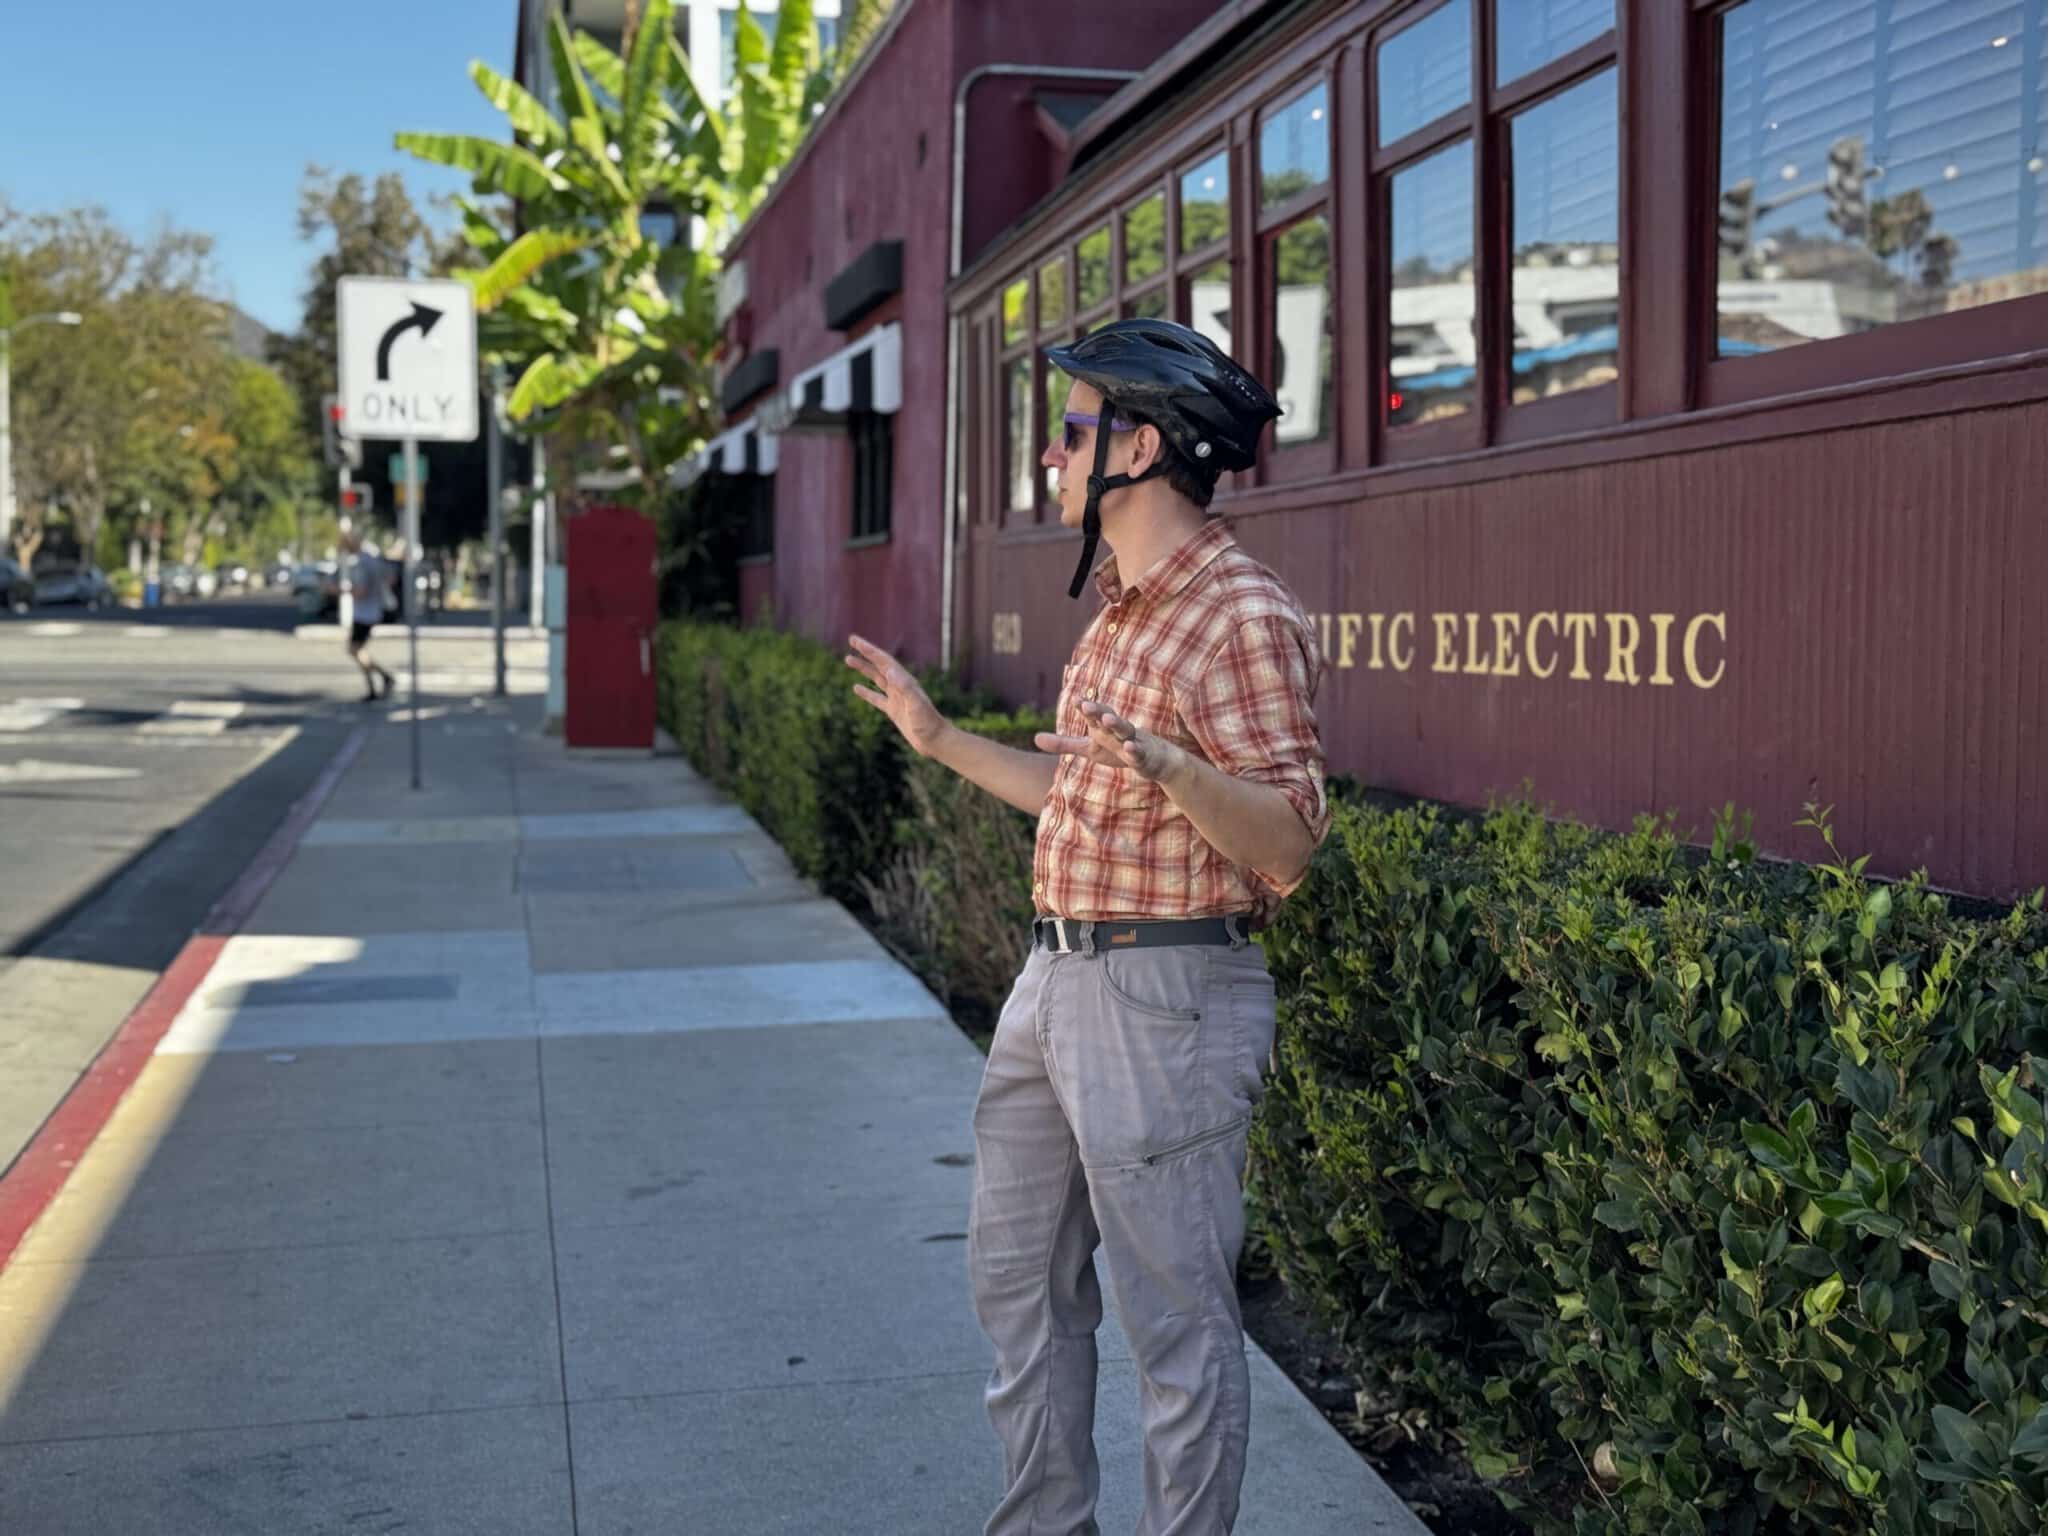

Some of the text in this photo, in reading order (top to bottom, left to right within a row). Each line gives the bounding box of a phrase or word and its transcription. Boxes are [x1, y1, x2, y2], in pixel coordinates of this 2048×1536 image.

[363, 393, 453, 422] ONLY
[1309, 611, 1727, 689] IFIC ELECTRIC
